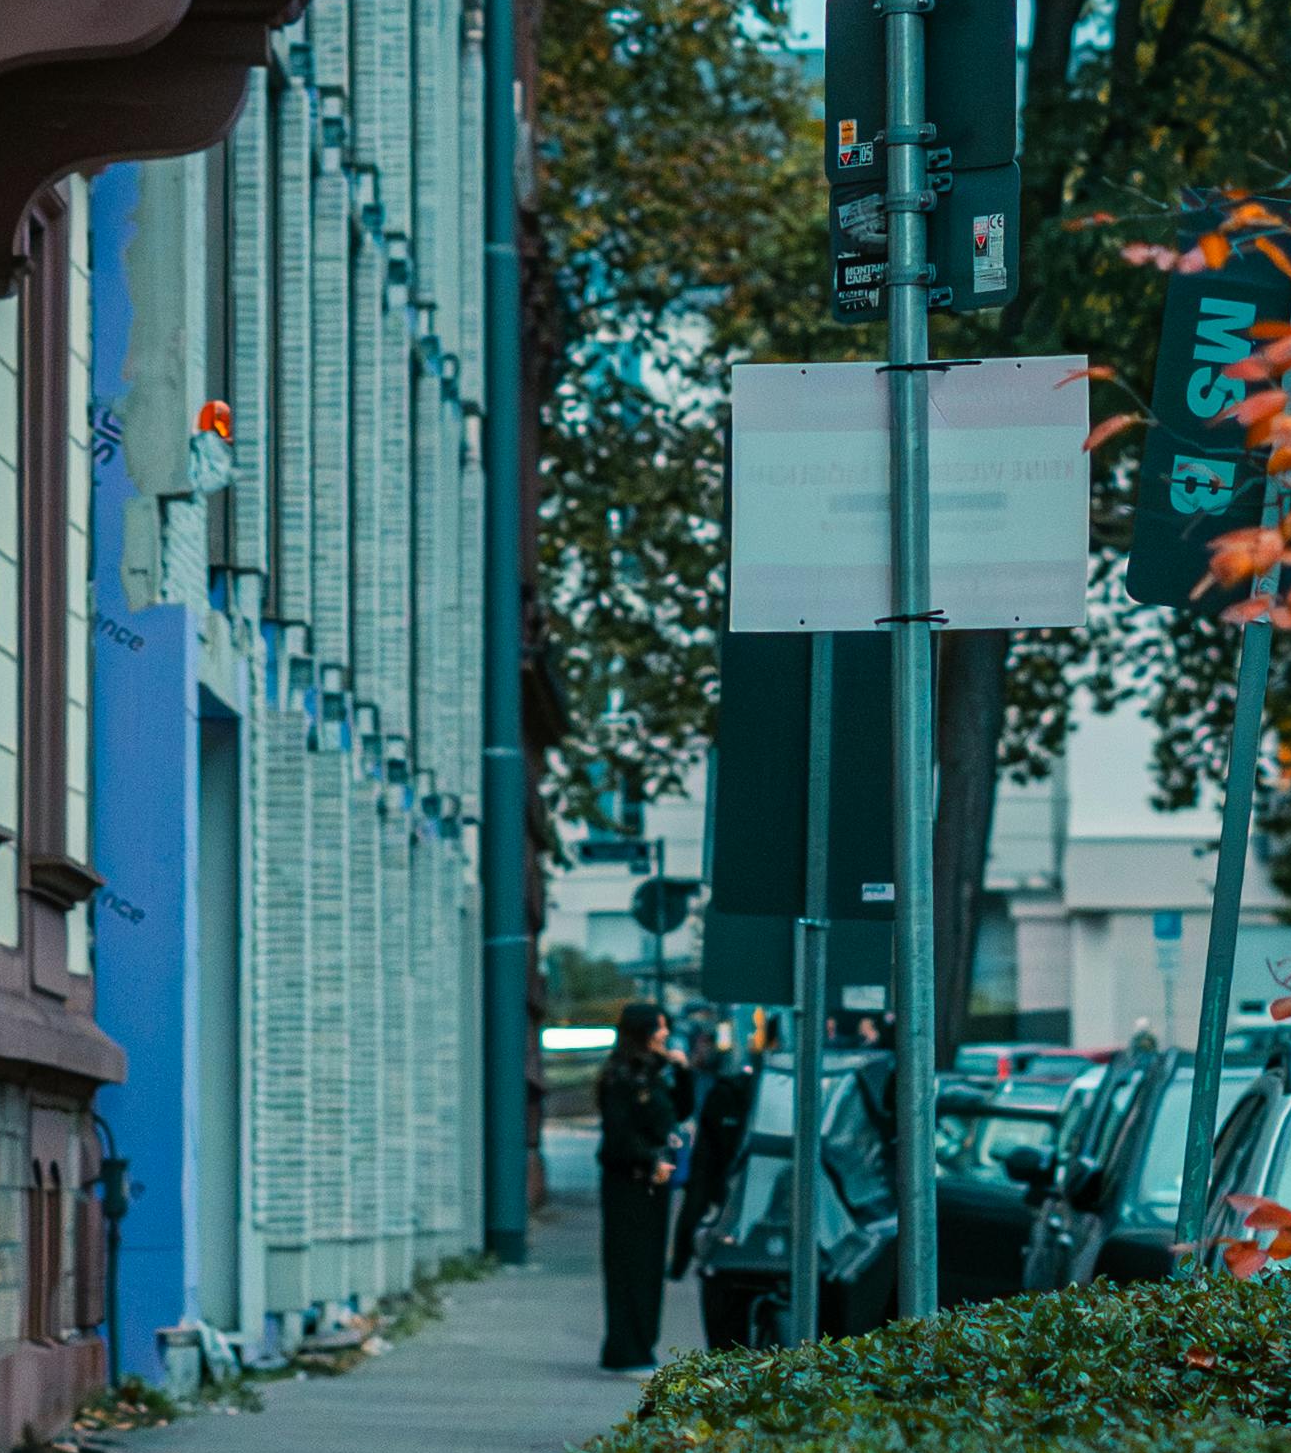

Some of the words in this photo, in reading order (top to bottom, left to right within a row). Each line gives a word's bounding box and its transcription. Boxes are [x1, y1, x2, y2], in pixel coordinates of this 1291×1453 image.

[989, 213, 1003, 229] CE
[1186, 297, 1257, 419] MS
[1169, 454, 1237, 516] B
